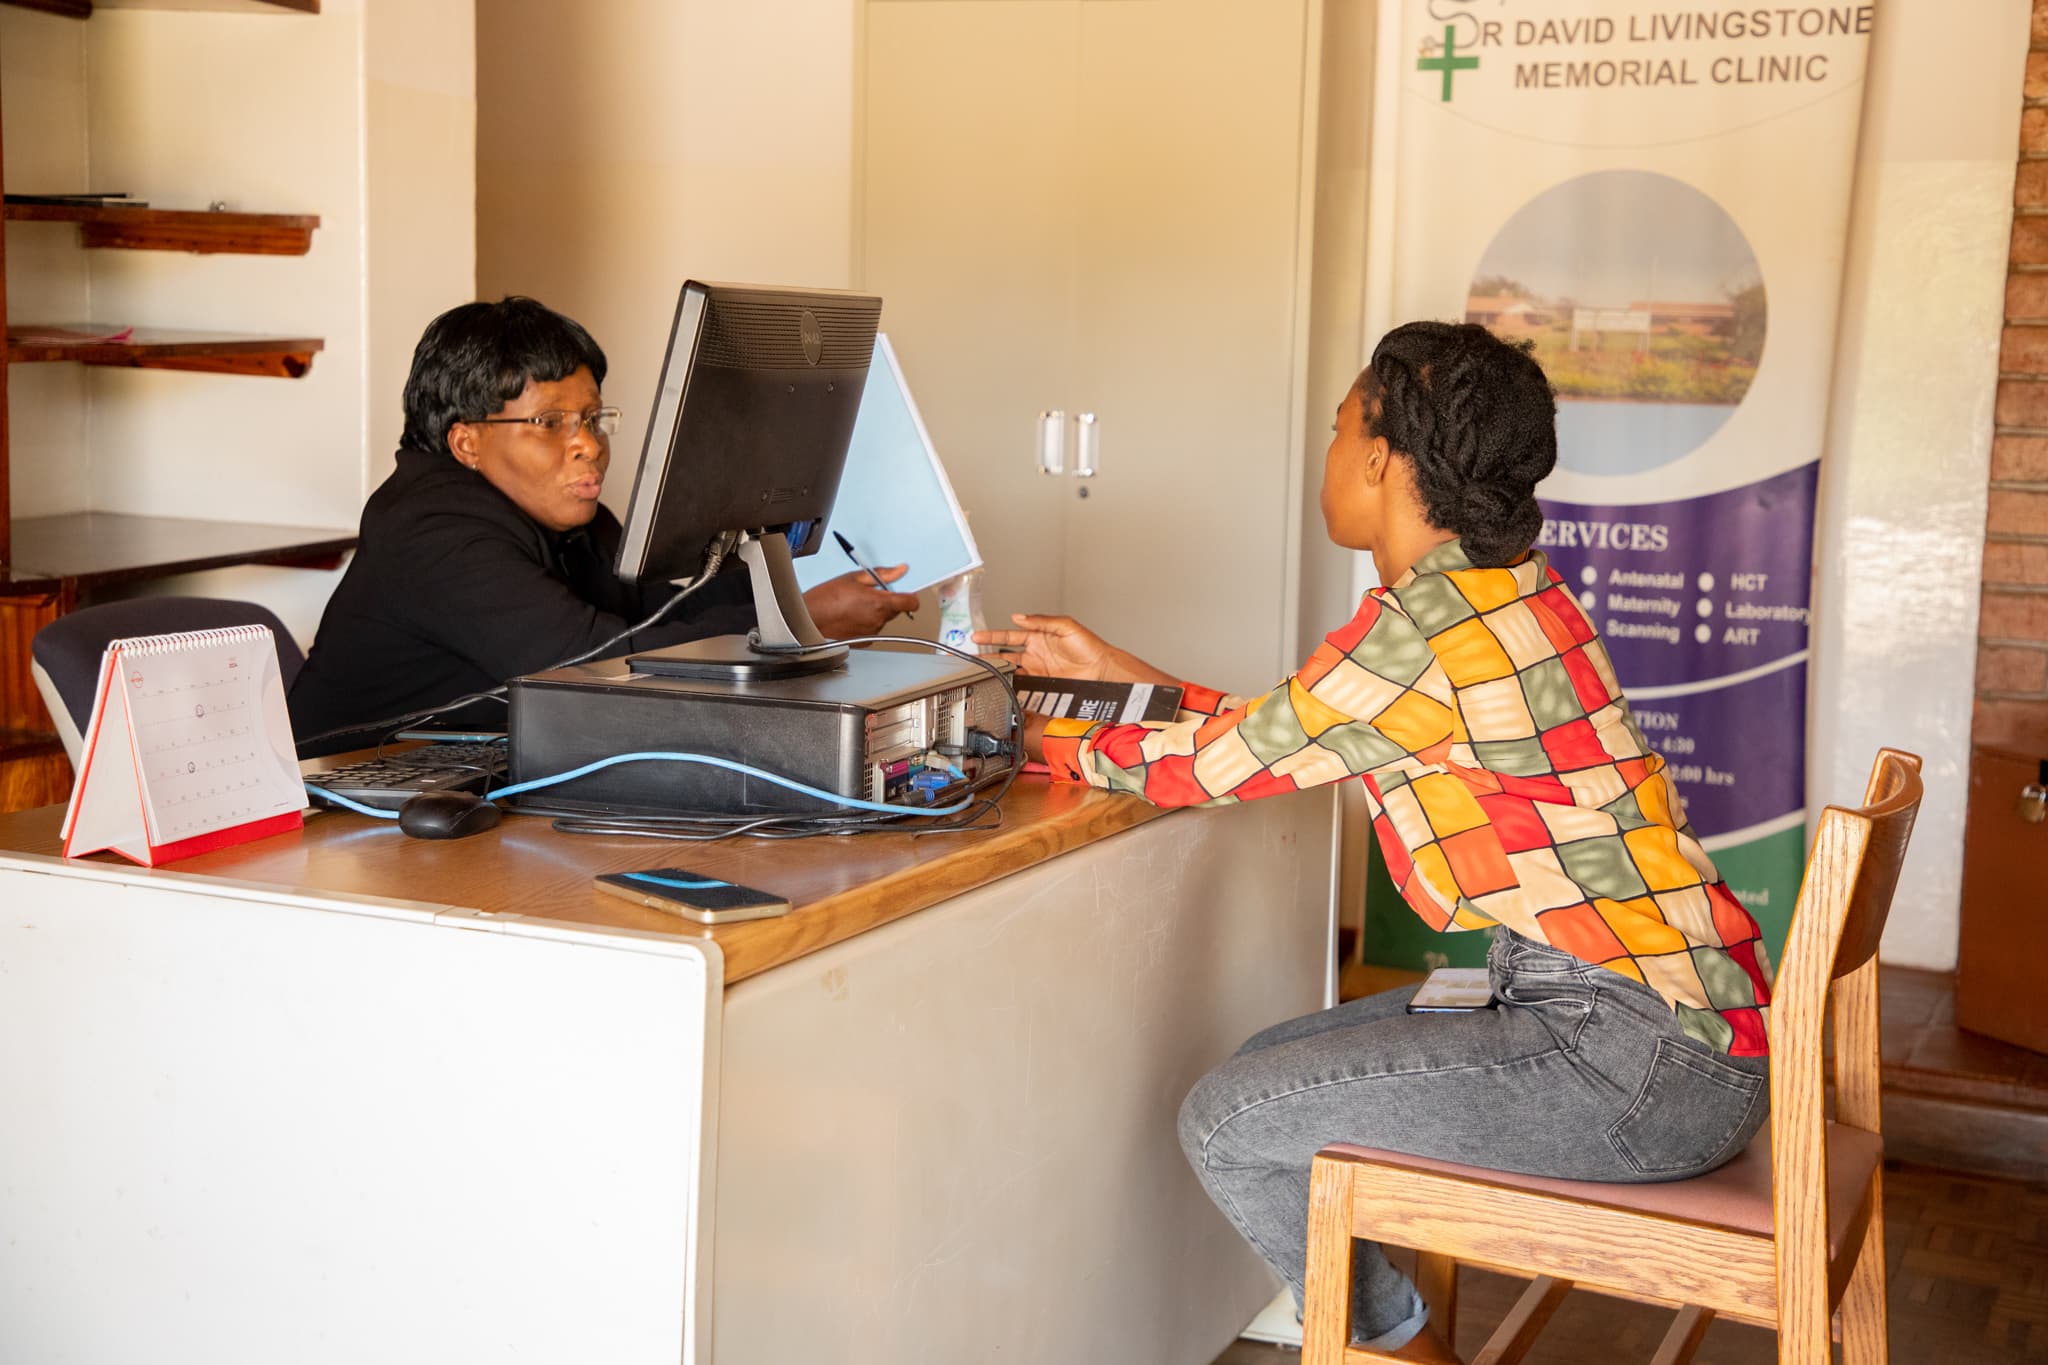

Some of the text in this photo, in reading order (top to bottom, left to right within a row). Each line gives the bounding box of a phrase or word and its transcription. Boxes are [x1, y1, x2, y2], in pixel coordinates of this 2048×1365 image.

[1515, 17, 1614, 46] DAVID
[1629, 6, 1873, 43] LIVINGSTONE
[1515, 54, 1829, 89] MEMORIAL CLINIC
[1538, 519, 1669, 552] ERVICES
[1608, 568, 1685, 590] Antenatal
[1730, 573, 1768, 592] HCT
[1607, 593, 1681, 619] Maternity
[1725, 600, 1810, 626] Laboratory
[1606, 618, 1681, 645] Scanning
[1723, 626, 1761, 647] ART
[1076, 699, 1100, 721] UIRE
[1633, 710, 1680, 731] TION
[1705, 766, 1735, 787] hrs
